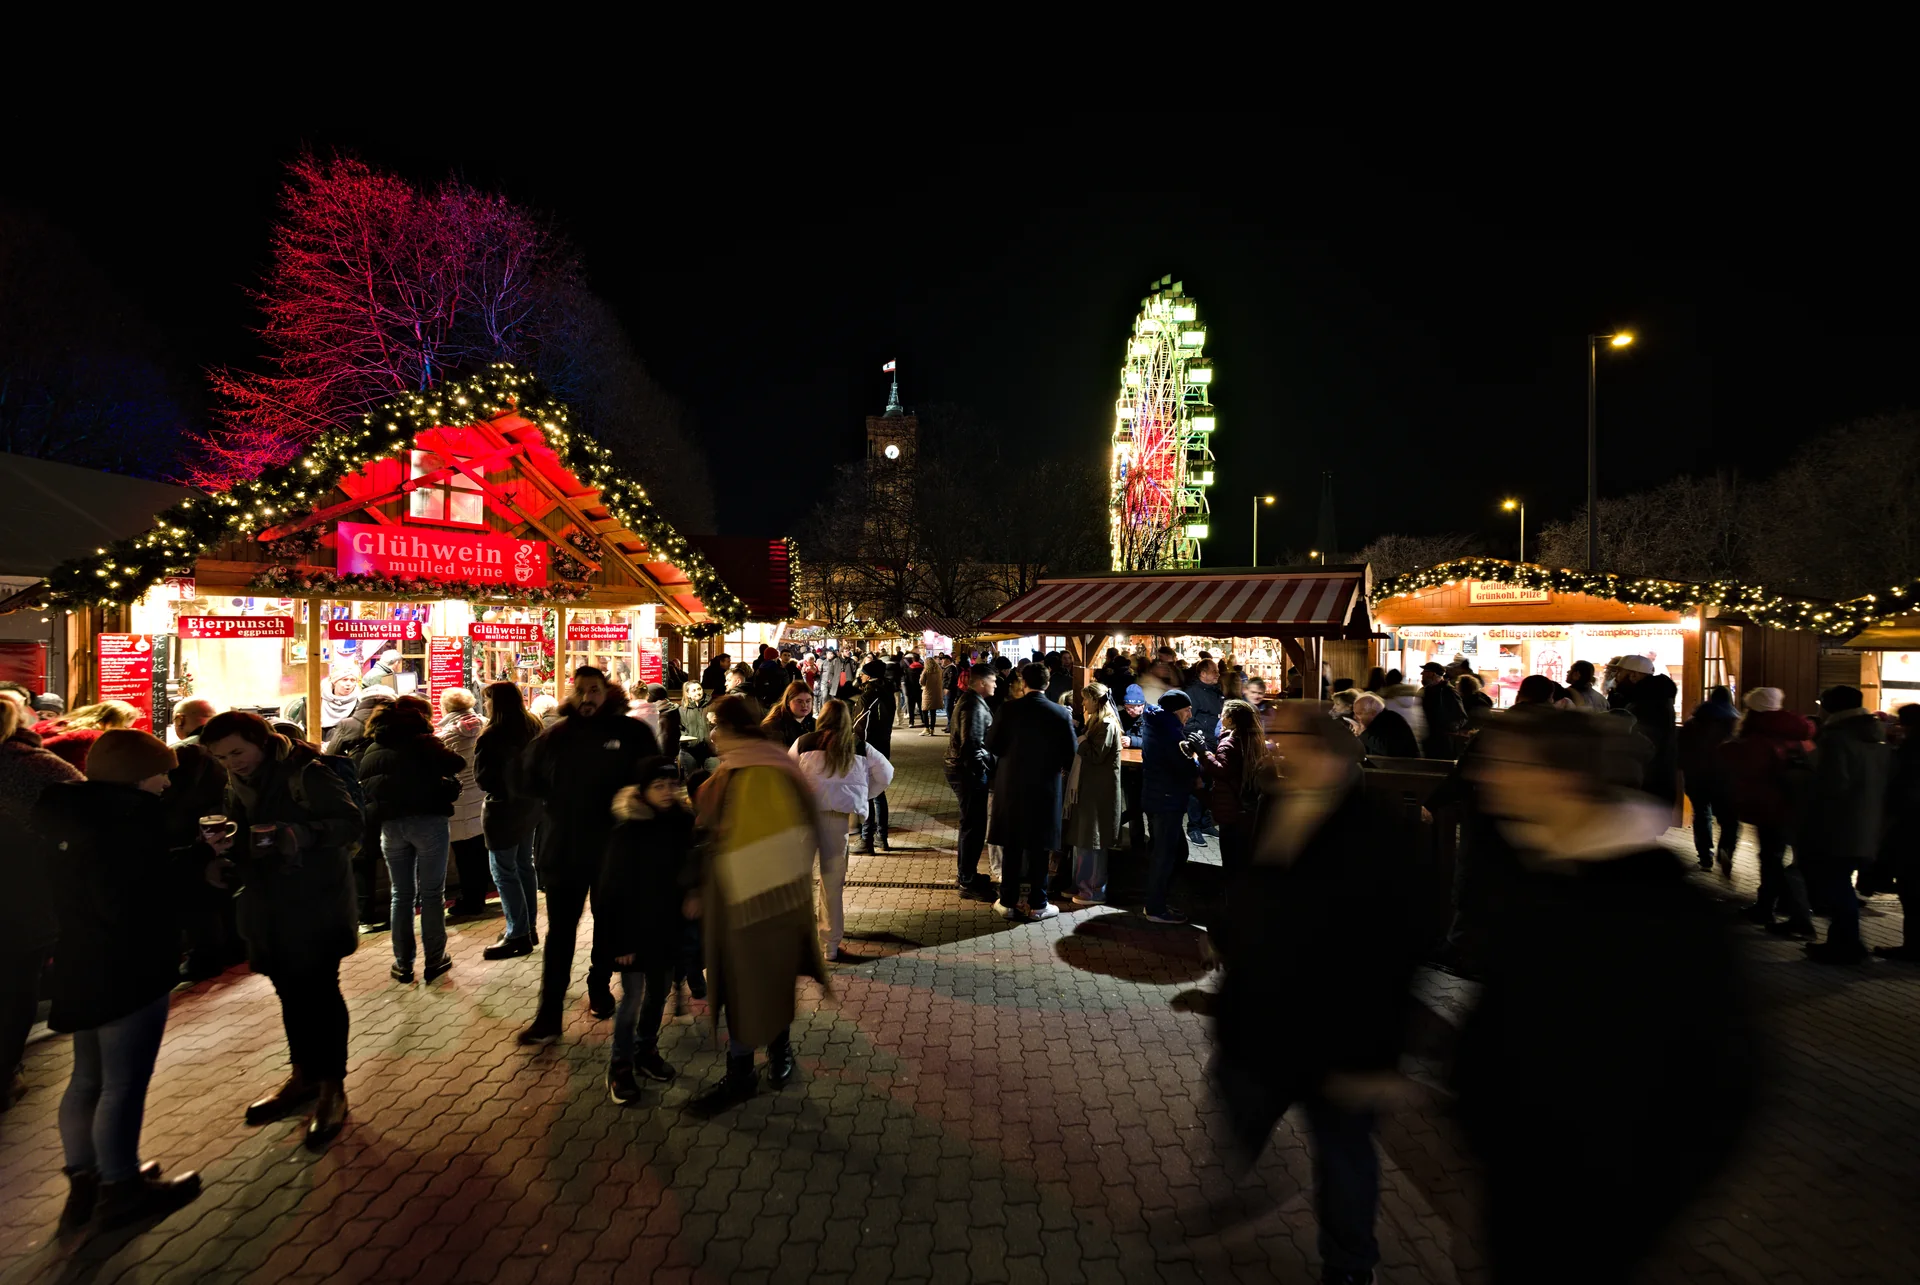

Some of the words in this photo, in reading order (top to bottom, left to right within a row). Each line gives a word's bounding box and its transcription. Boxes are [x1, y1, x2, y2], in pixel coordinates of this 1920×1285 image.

[353, 532, 503, 564] Glühwein
[389, 560, 455, 575] mulled
[462, 564, 503, 578] wine
[1476, 591, 1517, 600] Grünkohl,
[1520, 591, 1542, 599] Pilze
[187, 617, 285, 631] Eierpunsch
[334, 621, 402, 632] Glühwein
[473, 624, 527, 635] Glühwein
[591, 625, 628, 633] Schokolade
[237, 628, 286, 637] eggpunch
[1488, 629, 1561, 640] Geflügelleber
